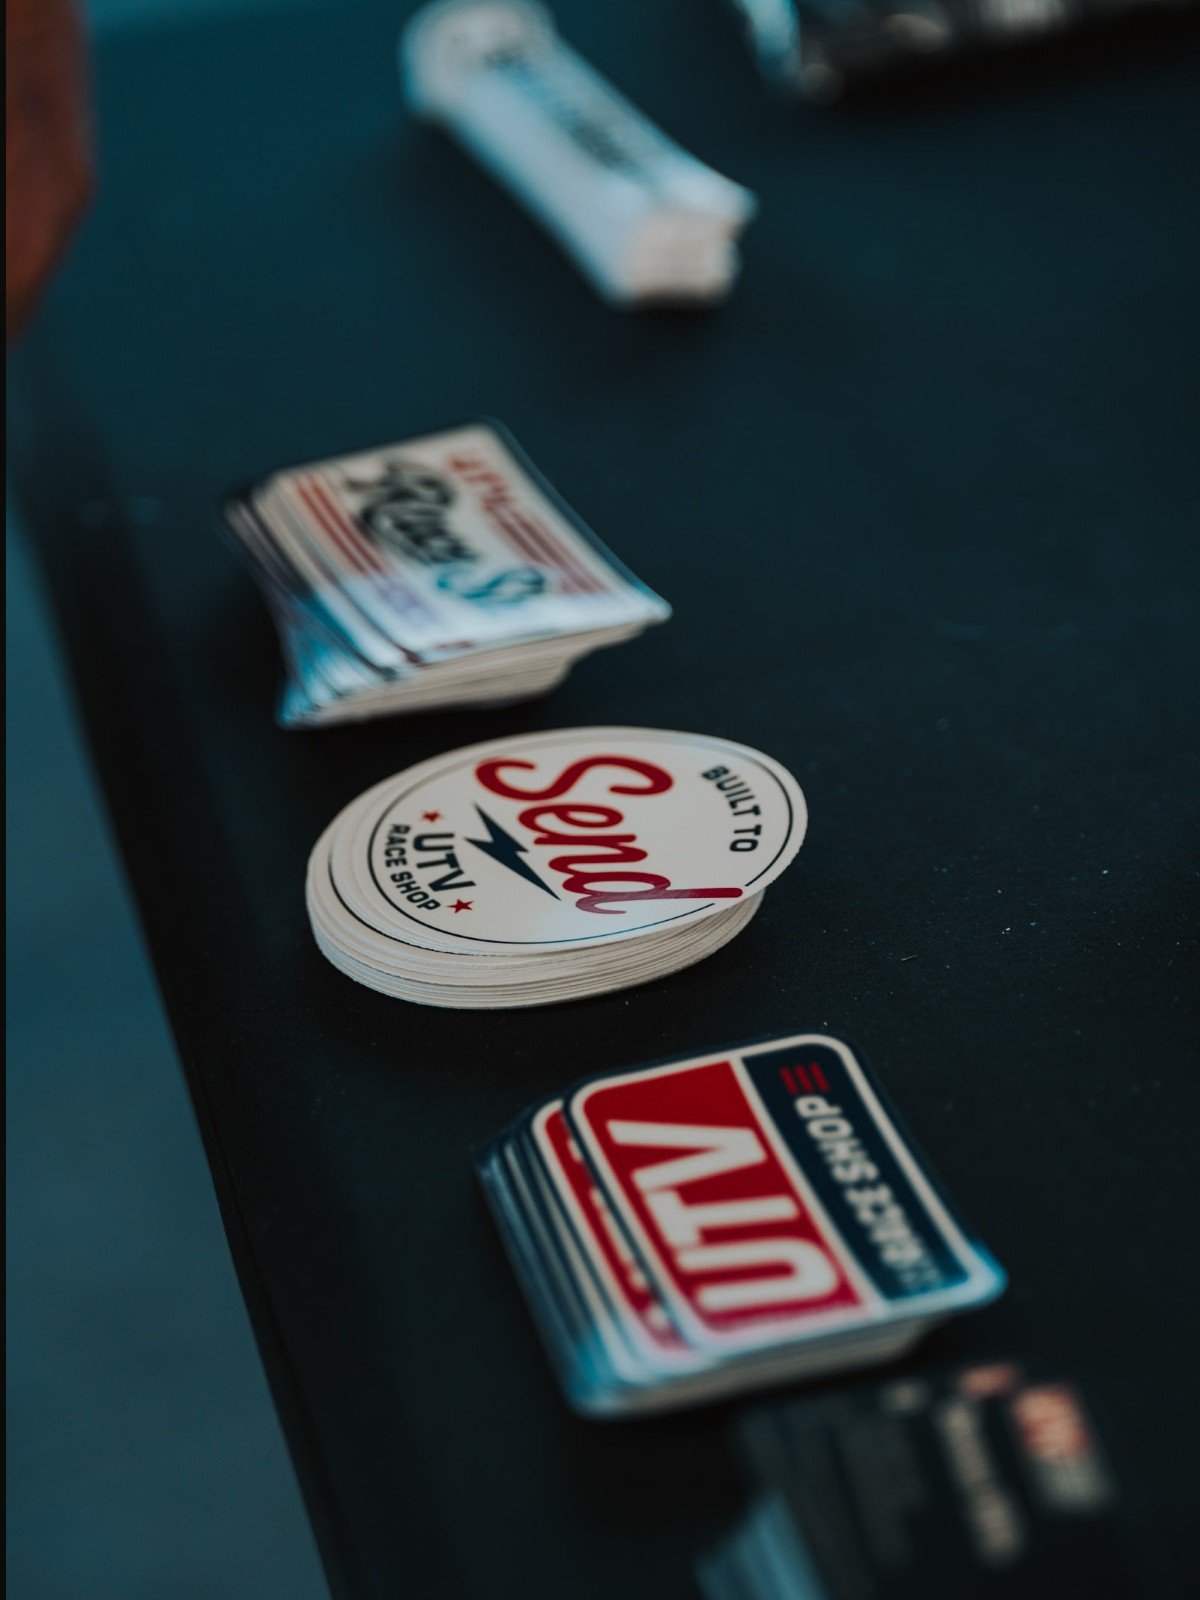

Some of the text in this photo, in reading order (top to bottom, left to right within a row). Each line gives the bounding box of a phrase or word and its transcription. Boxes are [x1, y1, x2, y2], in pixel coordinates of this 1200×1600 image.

[474, 754, 744, 915] Send
[701, 766, 762, 852] BUILT TO
[384, 824, 441, 910] RACE SHOP
[413, 832, 476, 892] UTV
[795, 1095, 880, 1182] SHOP
[606, 1119, 839, 1312] UTV
